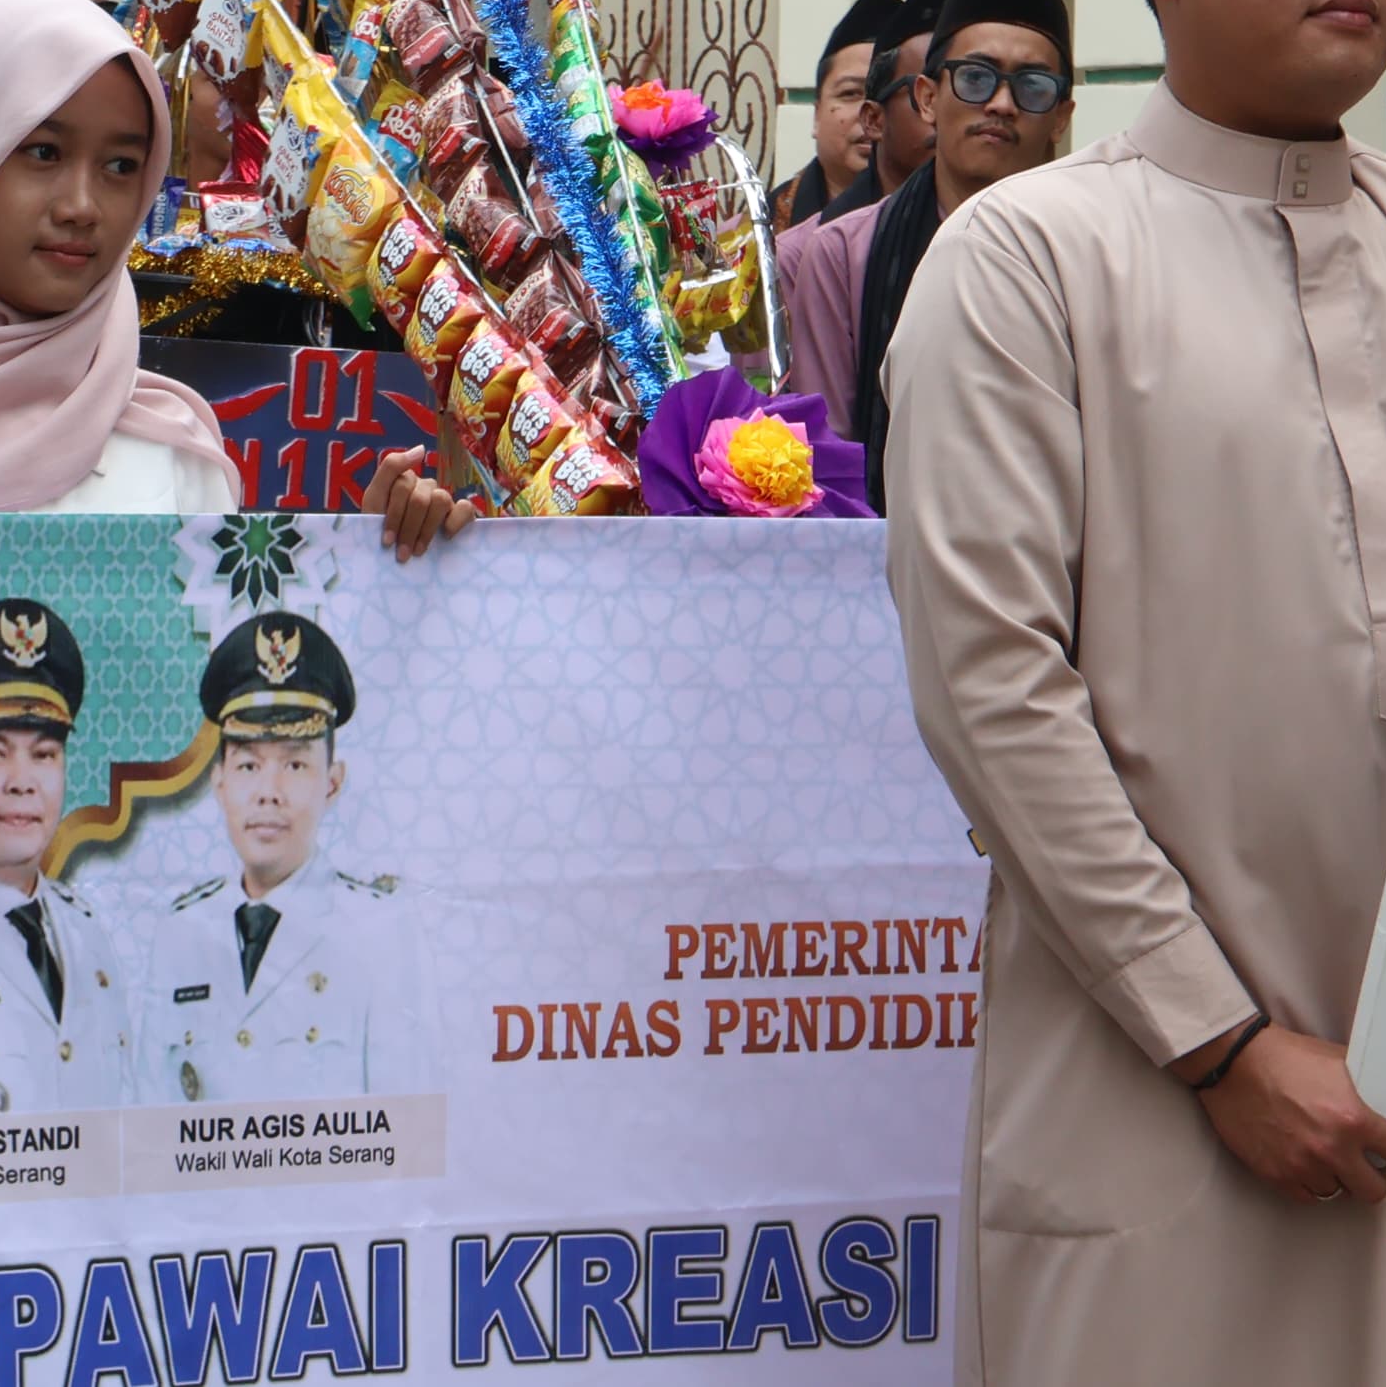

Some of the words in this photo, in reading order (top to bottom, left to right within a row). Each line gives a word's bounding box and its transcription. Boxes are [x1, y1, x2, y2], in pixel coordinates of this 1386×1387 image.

[382, 105, 421, 146] Rebo
[381, 238, 404, 268] Bee
[390, 222, 415, 256] Kris
[420, 294, 444, 325] Bee
[428, 278, 458, 312] Kris
[460, 351, 489, 382] Bee
[471, 338, 503, 369] Kris
[288, 348, 385, 436] 01
[512, 411, 539, 444] Bee
[519, 394, 551, 428] Kris
[555, 460, 588, 494] Bee
[569, 446, 603, 481] Kris
[492, 999, 682, 1062] DINAS
[179, 1118, 234, 1143] NUR
[242, 1114, 305, 1140] AGIS
[313, 1110, 391, 1136] AULIA
[175, 1151, 226, 1173] Wakil
[231, 1148, 274, 1170] Wali
[278, 1146, 322, 1168] Kota
[327, 1143, 396, 1168] Serang
[451, 1214, 942, 1368] KREASI
